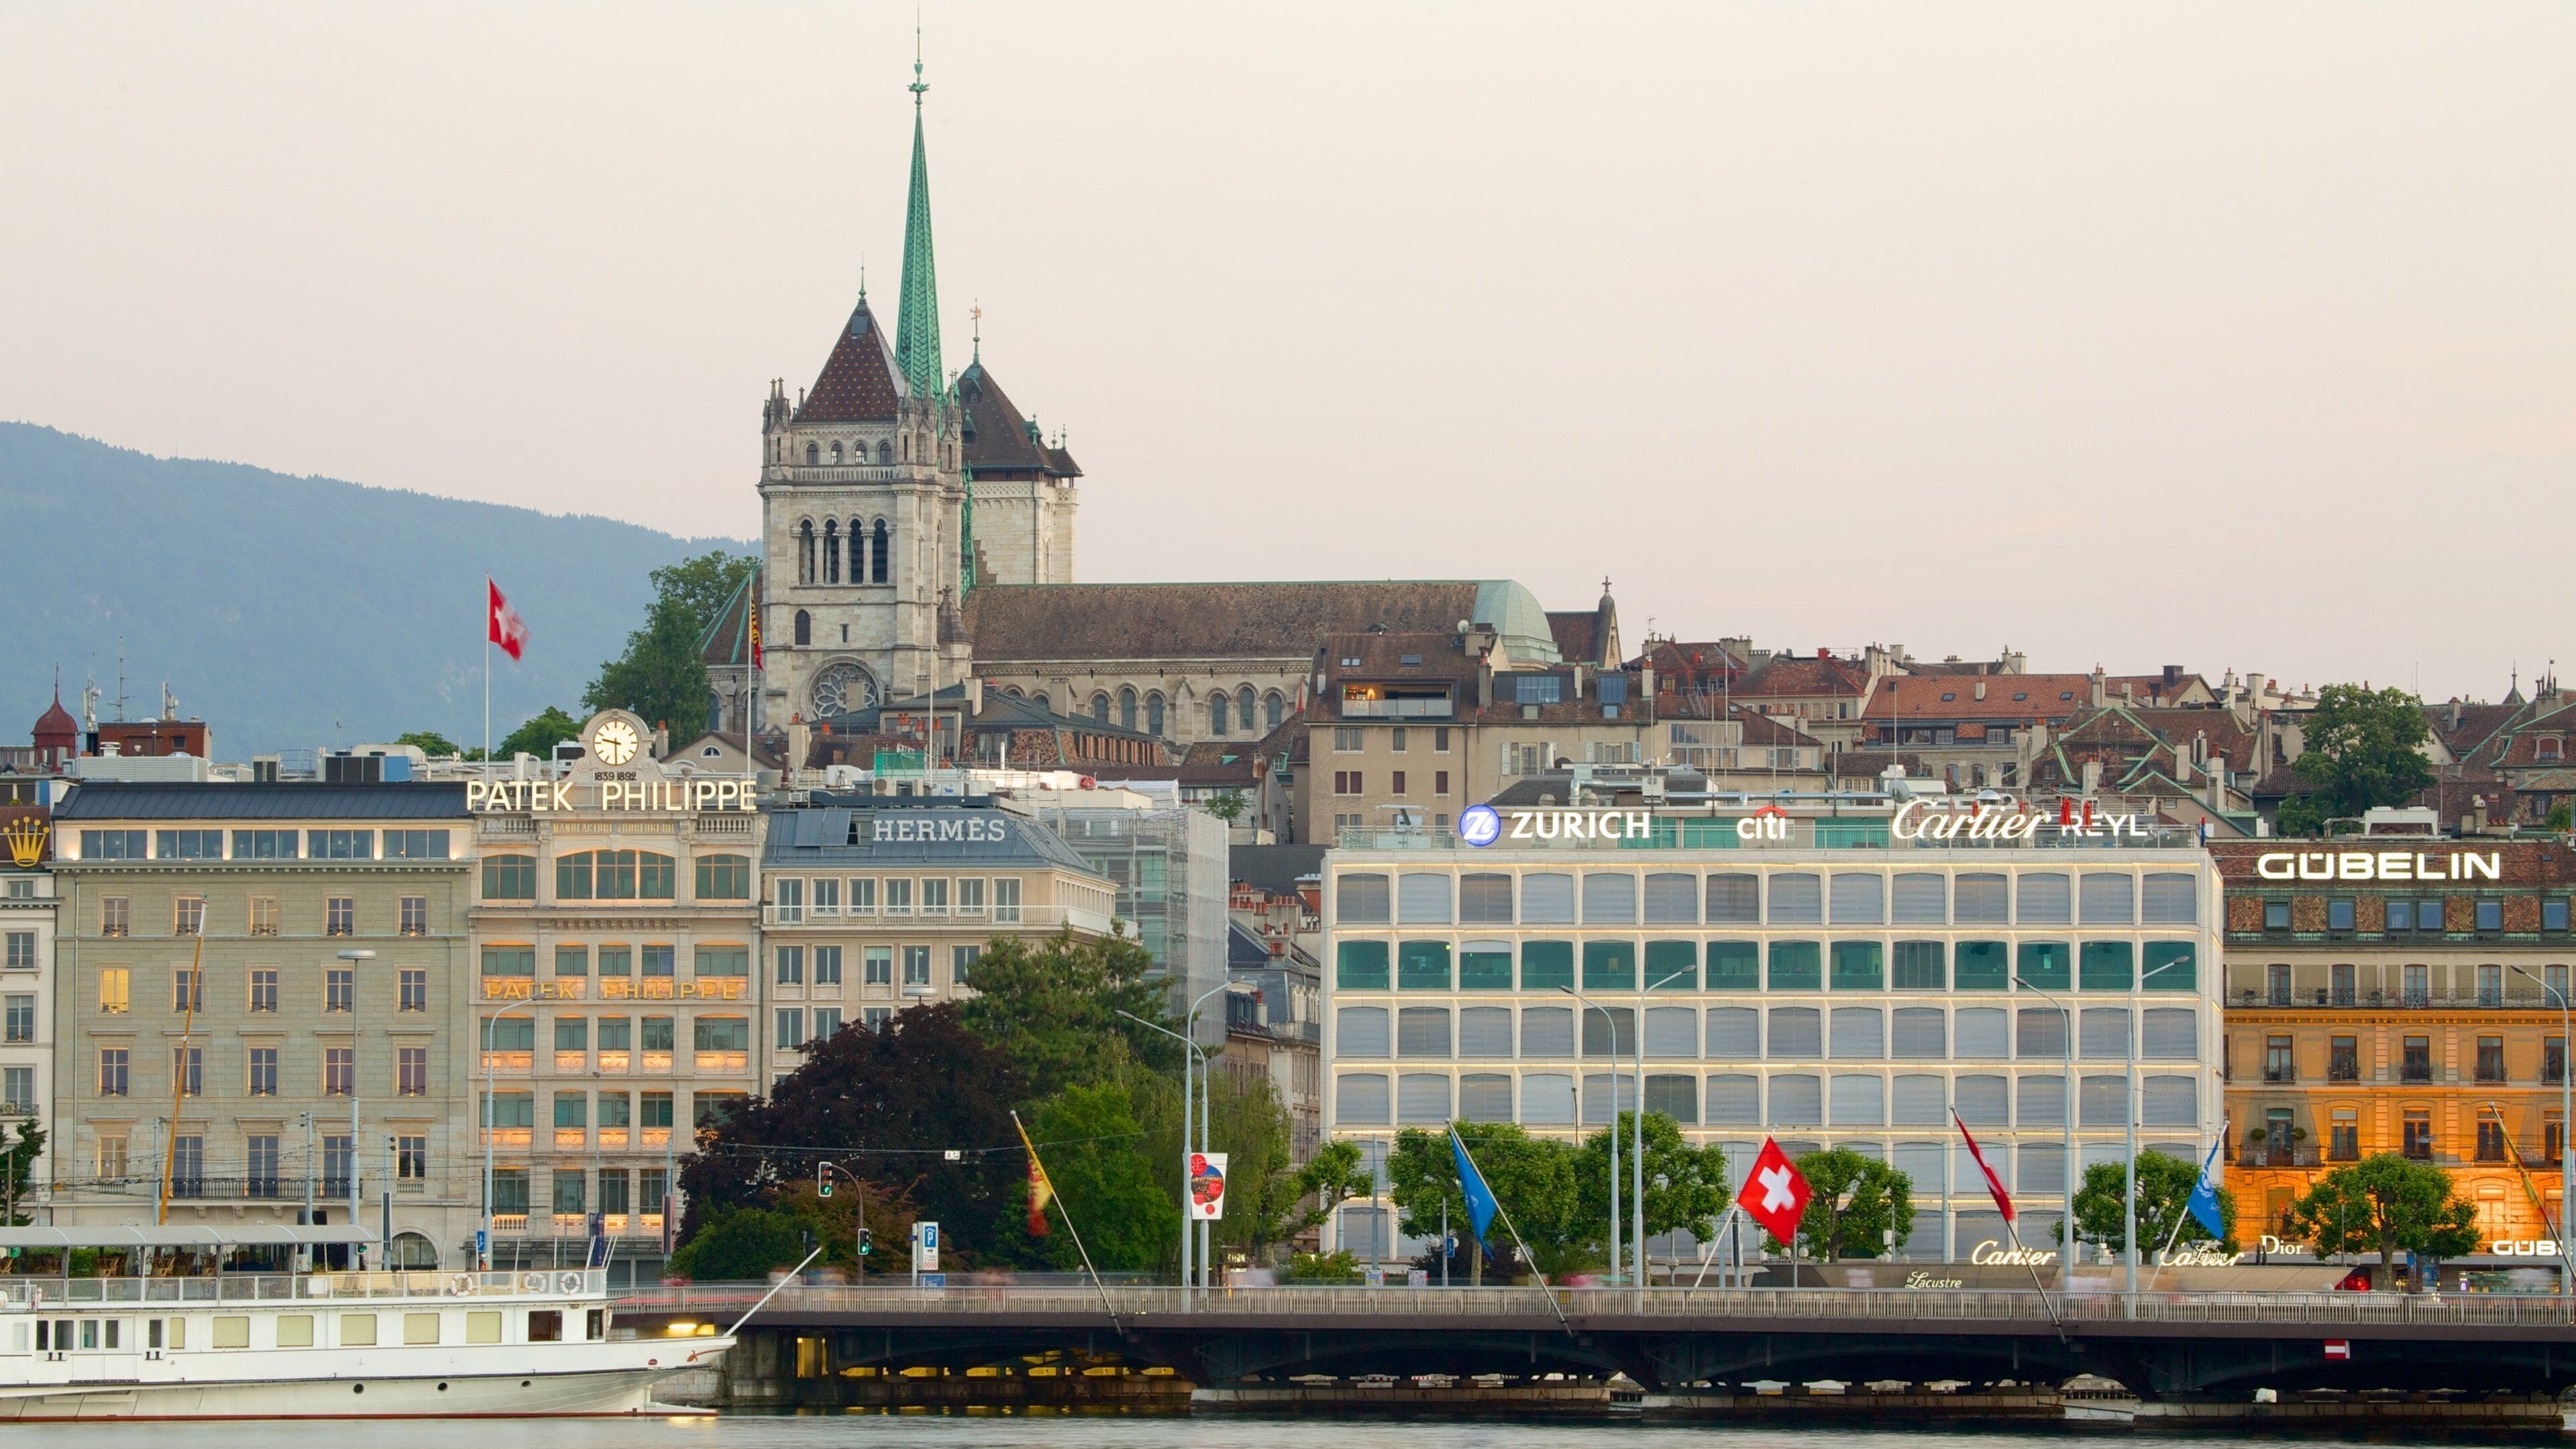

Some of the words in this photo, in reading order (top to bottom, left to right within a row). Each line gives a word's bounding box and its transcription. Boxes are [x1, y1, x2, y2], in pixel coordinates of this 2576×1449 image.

[594, 771, 614, 781] 1839
[616, 771, 637, 781] 1892
[466, 780, 574, 811] PATEK
[602, 780, 757, 811] PHILIPPE
[873, 817, 1006, 841] HERMÈS
[1510, 811, 1650, 839] ZURICH
[1736, 810, 1786, 840] citi
[1892, 800, 2051, 840] Cartier
[2061, 814, 2148, 837] REYL
[2257, 852, 2500, 880] GÜBELIN
[485, 981, 576, 1000] PATEK
[602, 981, 739, 1000] PHILIPPE
[1971, 1240, 2057, 1266] Cartier
[2260, 1234, 2304, 1255] Dior
[1905, 1271, 1962, 1289] Lacustre
